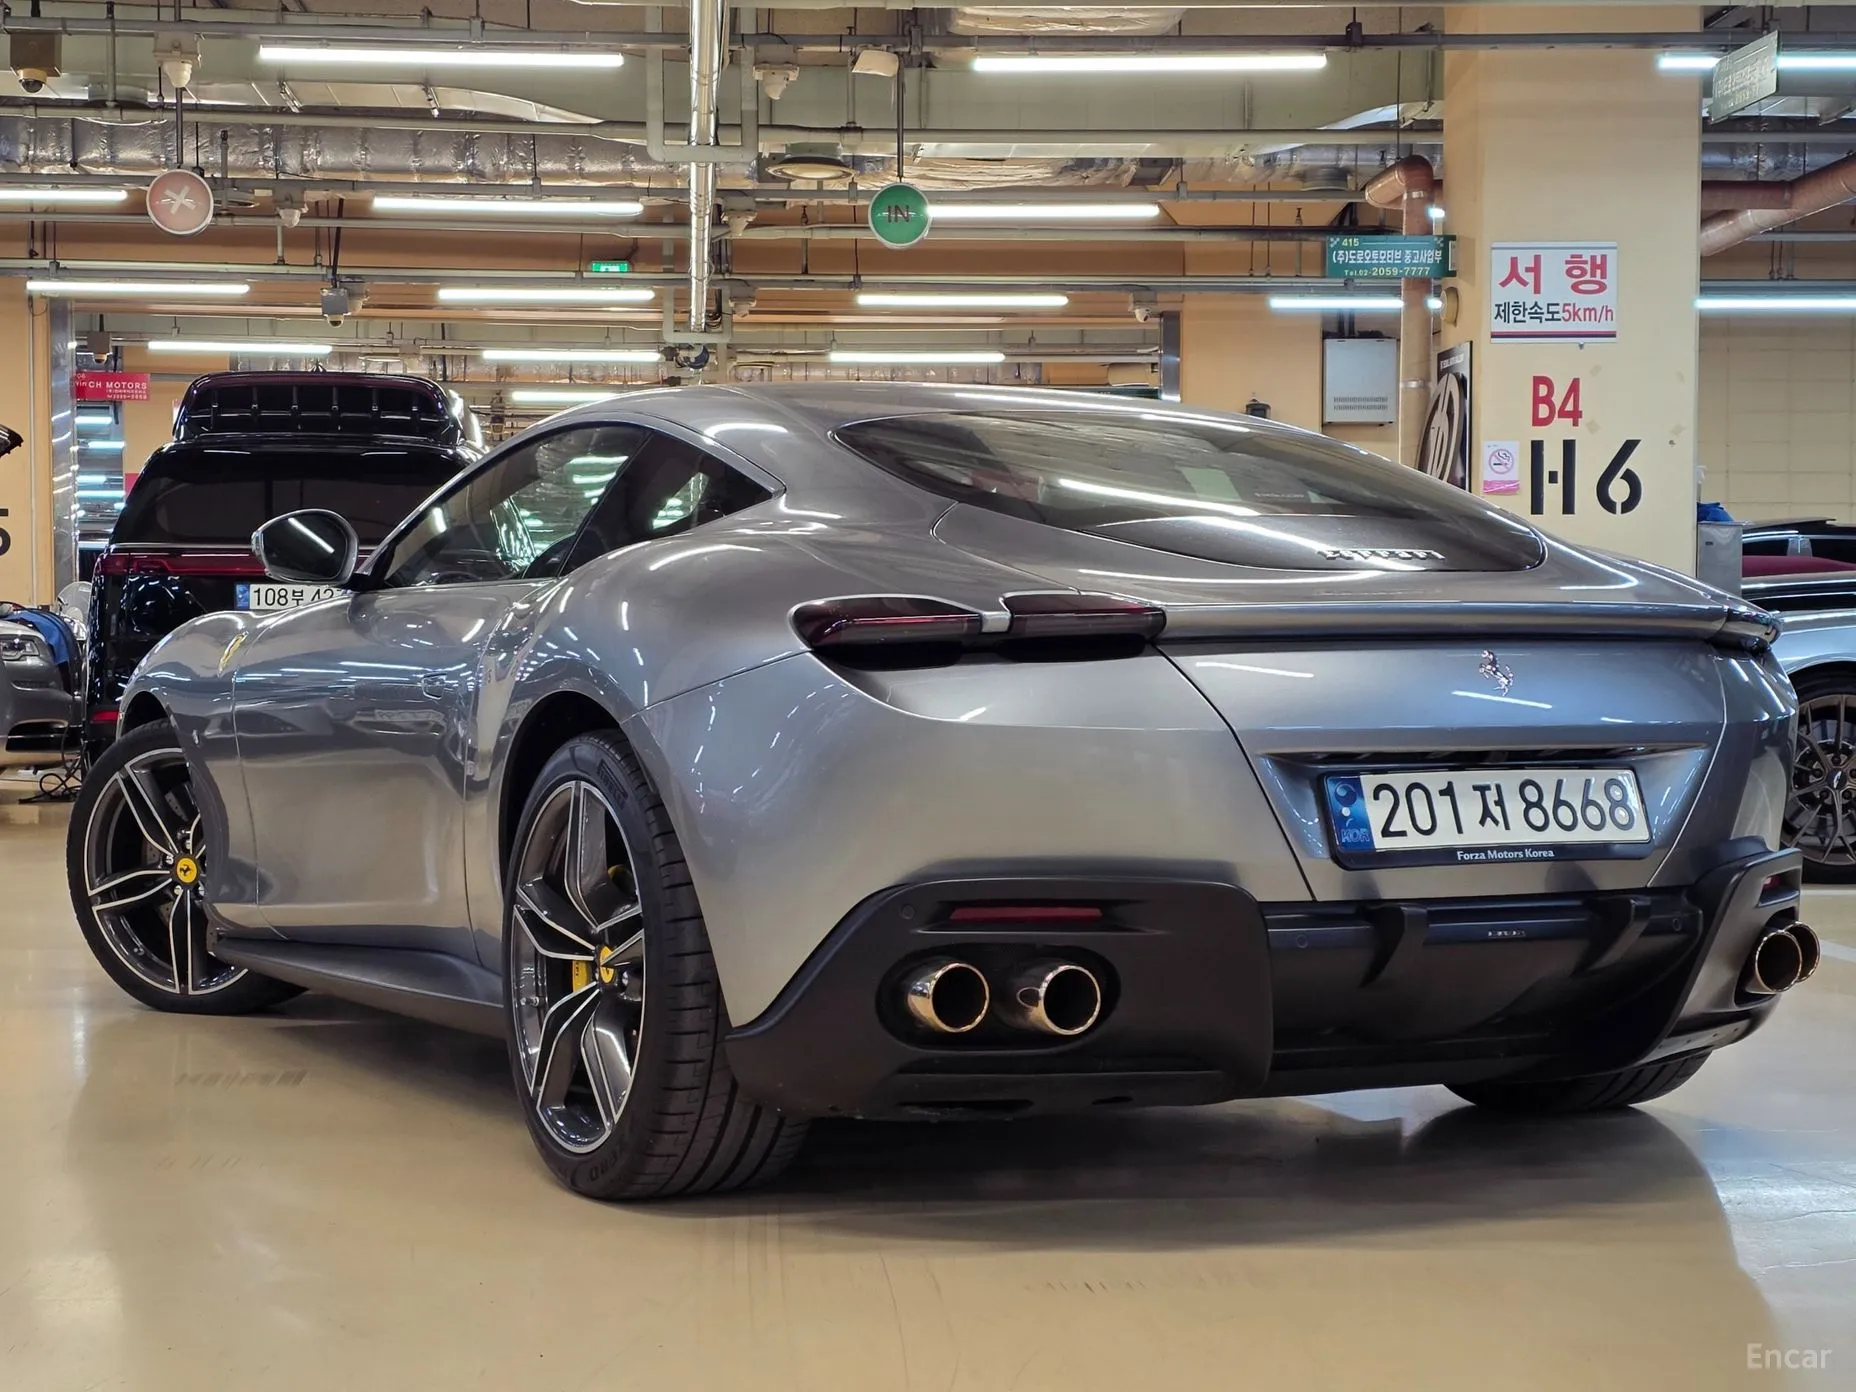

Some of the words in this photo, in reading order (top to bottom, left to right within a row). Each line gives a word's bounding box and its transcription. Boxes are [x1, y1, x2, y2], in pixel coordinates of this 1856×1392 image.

[887, 205, 910, 223] IN
[1341, 238, 1360, 247] 415
[106, 381, 147, 390] MOTORS
[1531, 375, 1583, 427] B4
[1457, 850, 1486, 861] Forza
[1488, 849, 1523, 860] Motors
[1525, 848, 1555, 858] Korea
